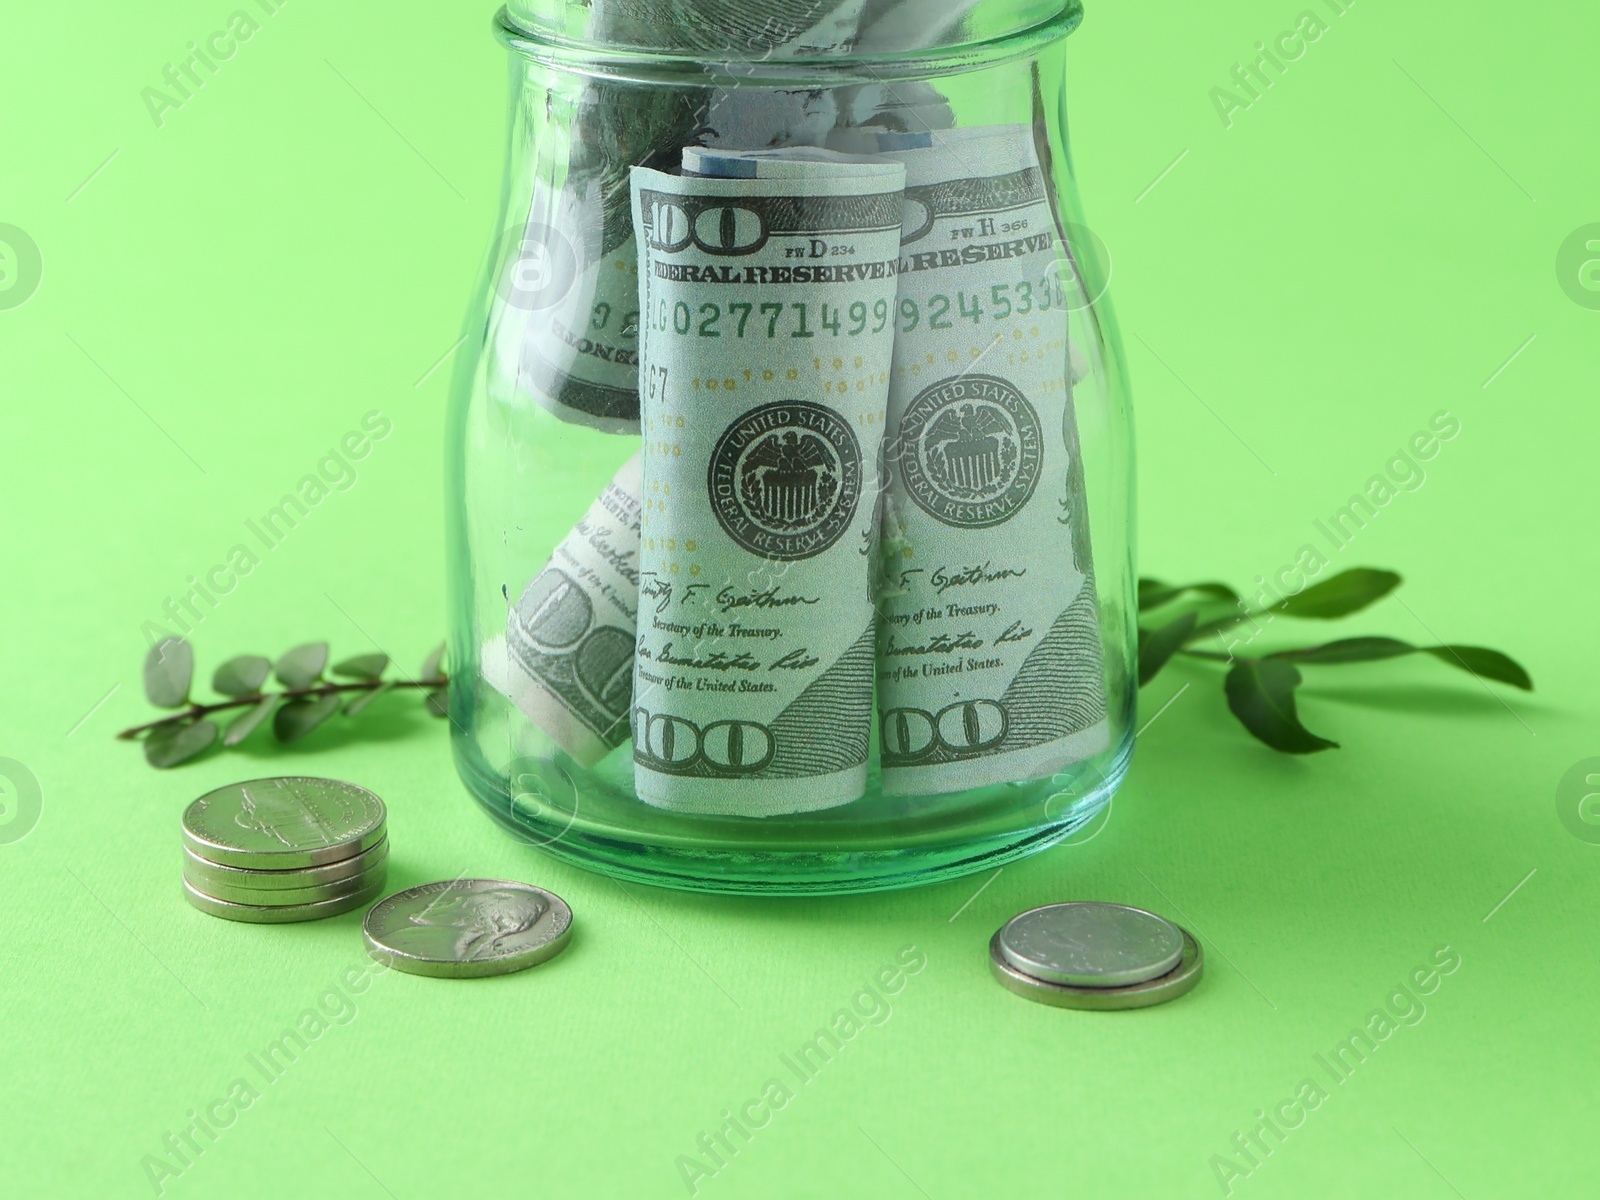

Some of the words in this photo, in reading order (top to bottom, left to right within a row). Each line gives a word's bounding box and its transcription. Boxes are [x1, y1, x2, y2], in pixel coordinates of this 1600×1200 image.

[650, 200, 769, 257] 100
[978, 217, 996, 237] H
[1000, 219, 1029, 234] 366
[809, 239, 827, 258] D
[831, 246, 856, 256] 234
[911, 231, 1052, 271] RESERVE
[654, 261, 742, 284] FEDERAL
[743, 262, 885, 284] RESERVE
[909, 384, 966, 426] UNITED
[971, 383, 1020, 412] STATES
[730, 410, 791, 448] UNITED
[798, 411, 846, 447] STATES
[1014, 424, 1038, 493] SYSTEM
[826, 460, 858, 530] SYSTEM
[904, 441, 941, 509] FEDERAL
[943, 493, 1016, 520] RESERVE
[717, 464, 750, 536] FEDERAL
[753, 528, 828, 551] RESERVE
[652, 616, 691, 638] Secretary
[693, 623, 707, 638] of
[707, 623, 725, 637] the
[729, 624, 783, 641] Treasury.
[913, 609, 924, 624] of
[926, 607, 942, 620] the
[946, 603, 1001, 618] Treasury.
[664, 676, 677, 691] of
[676, 676, 693, 690] the
[696, 679, 736, 693] United
[738, 679, 778, 693] States.
[892, 666, 903, 682] of
[902, 666, 918, 679] the
[922, 659, 963, 678] United
[966, 658, 1004, 671] States.
[634, 706, 778, 774] 100
